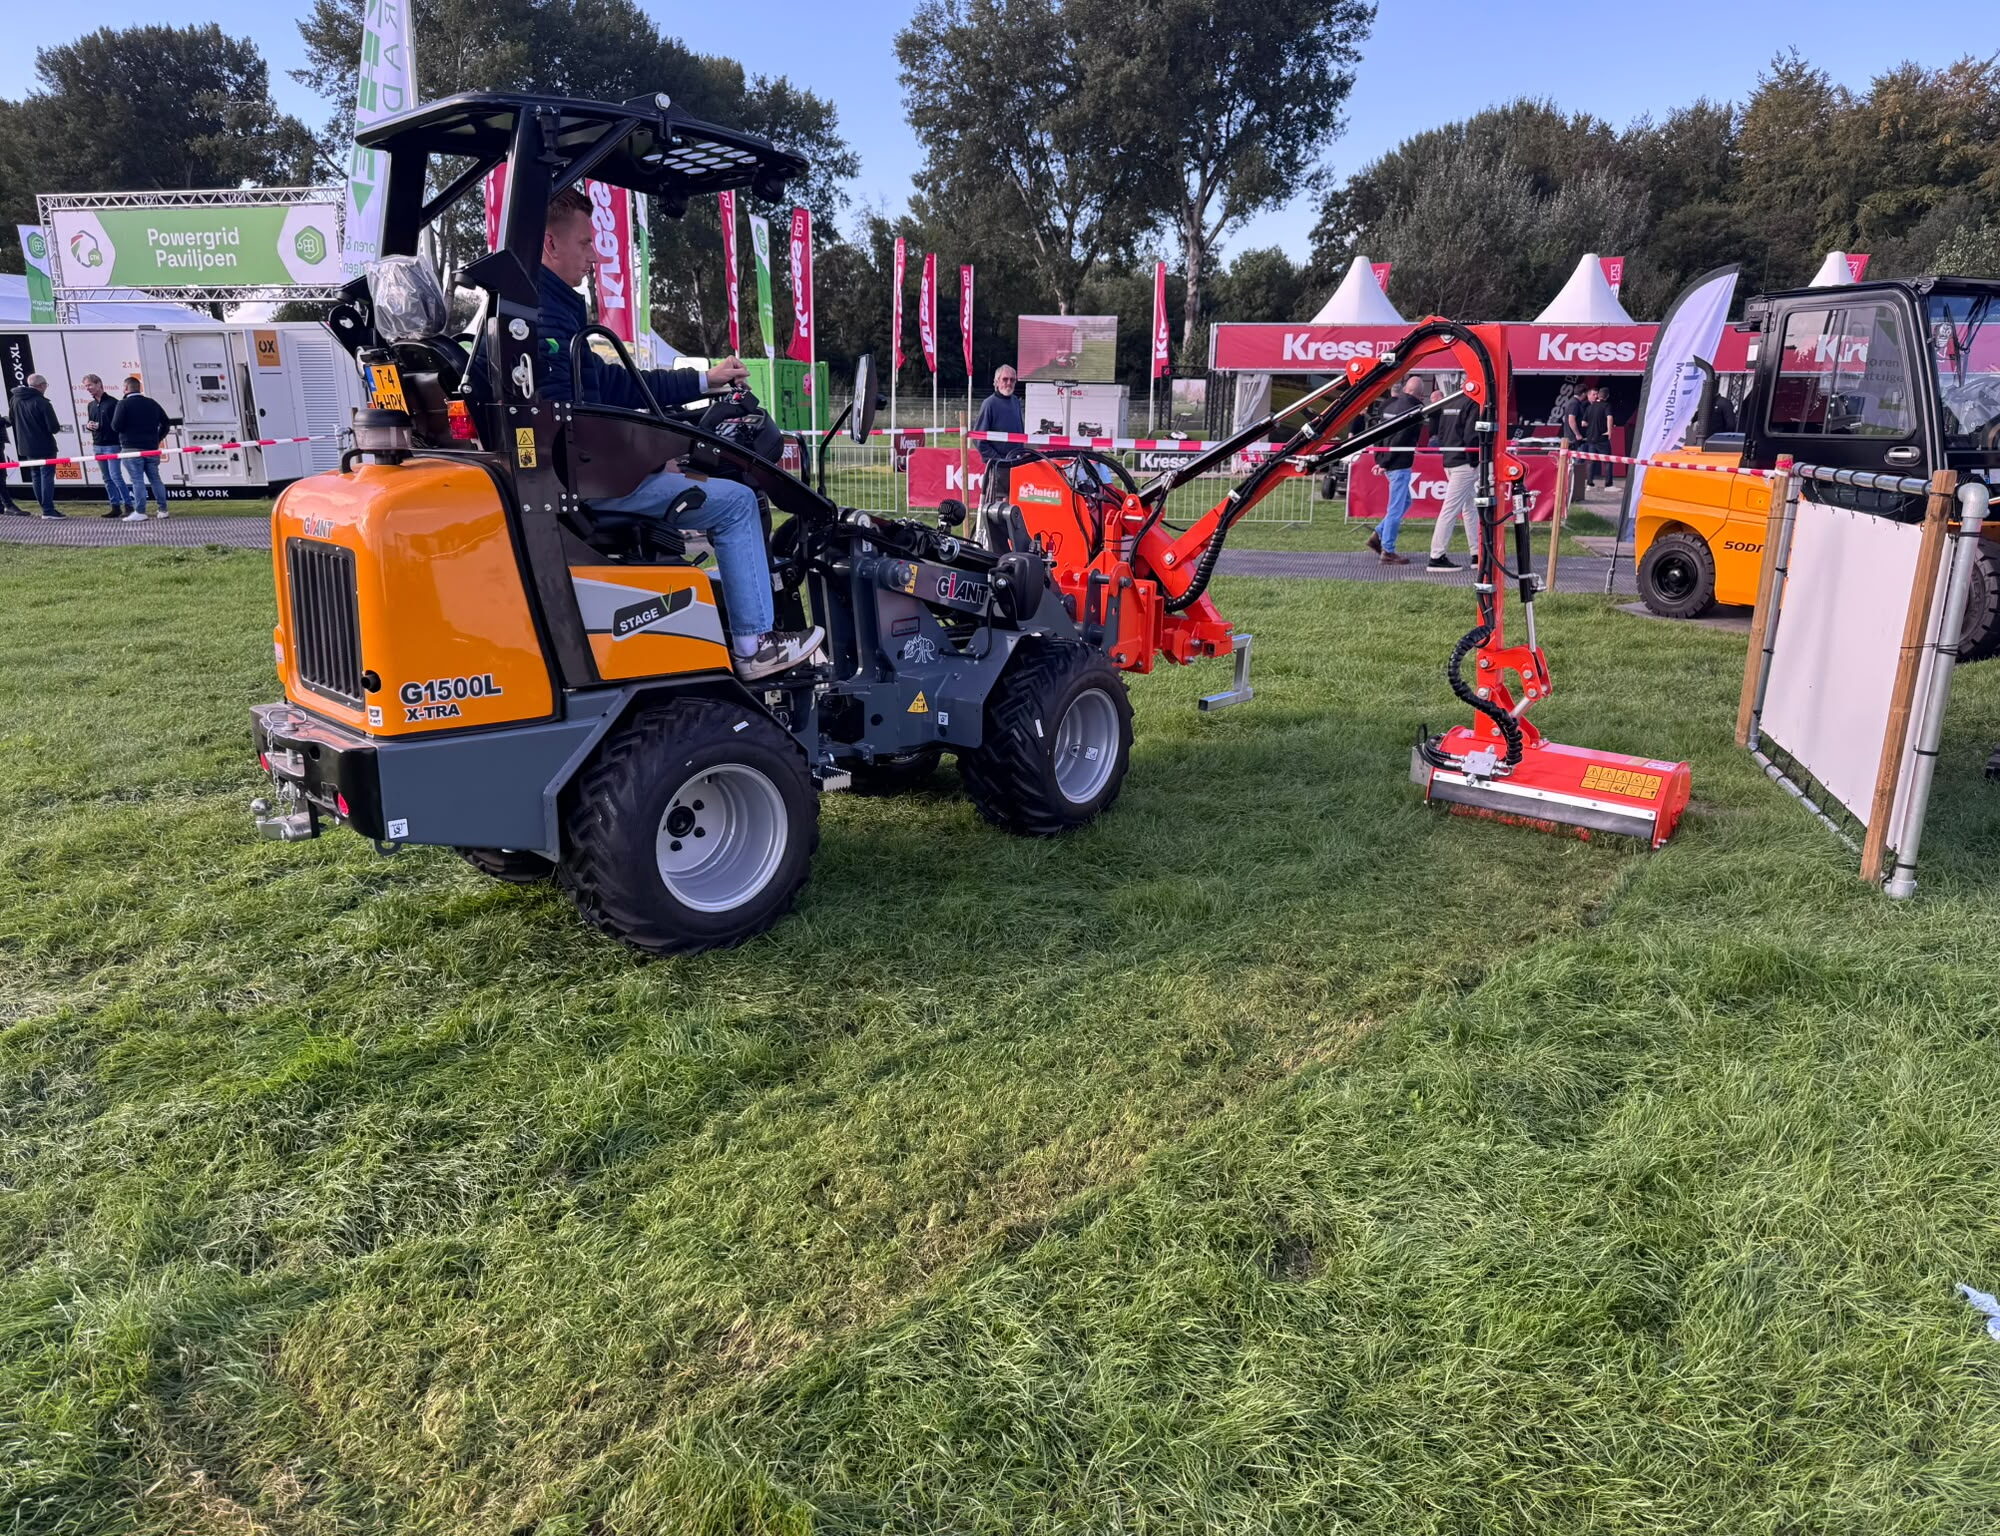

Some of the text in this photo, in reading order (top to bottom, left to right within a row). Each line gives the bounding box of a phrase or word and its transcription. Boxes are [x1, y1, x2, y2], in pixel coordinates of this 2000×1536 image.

[147, 227, 240, 247] Powergrid
[155, 250, 237, 271] Paviljoen
[1282, 333, 1373, 361] Kress
[1538, 333, 1636, 362] Kress
[197, 489, 229, 498] WORK
[620, 607, 660, 632] STAGE
[399, 673, 503, 706] G1500L
[404, 703, 461, 722] X-TRA
